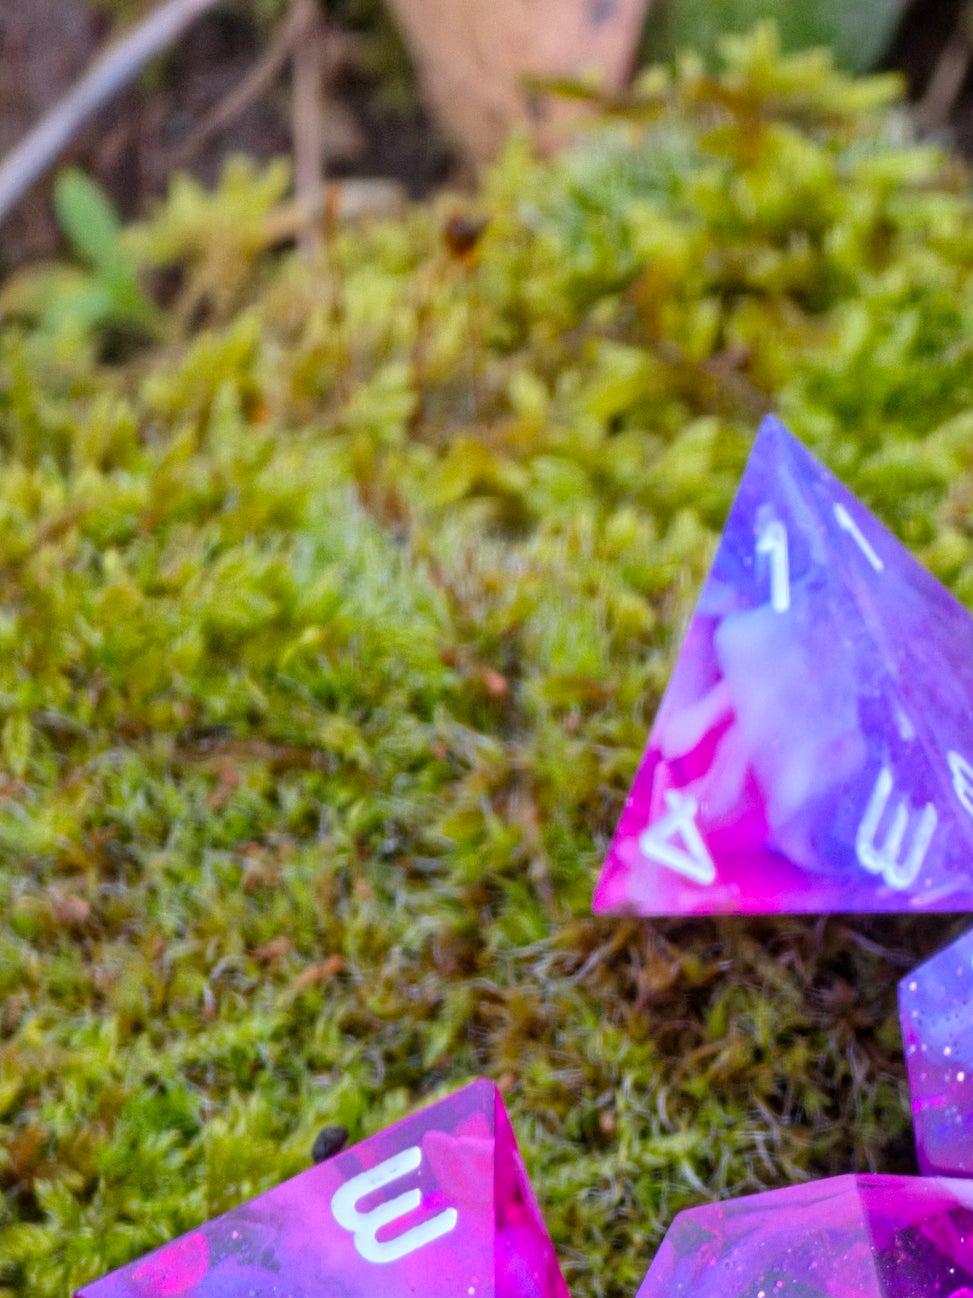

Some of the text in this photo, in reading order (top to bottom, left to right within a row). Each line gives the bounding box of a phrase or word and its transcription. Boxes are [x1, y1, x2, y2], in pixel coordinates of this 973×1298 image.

[757, 520, 790, 613] 1
[639, 789, 715, 885] 4
[856, 766, 938, 890] 3
[330, 1145, 458, 1265] 3
